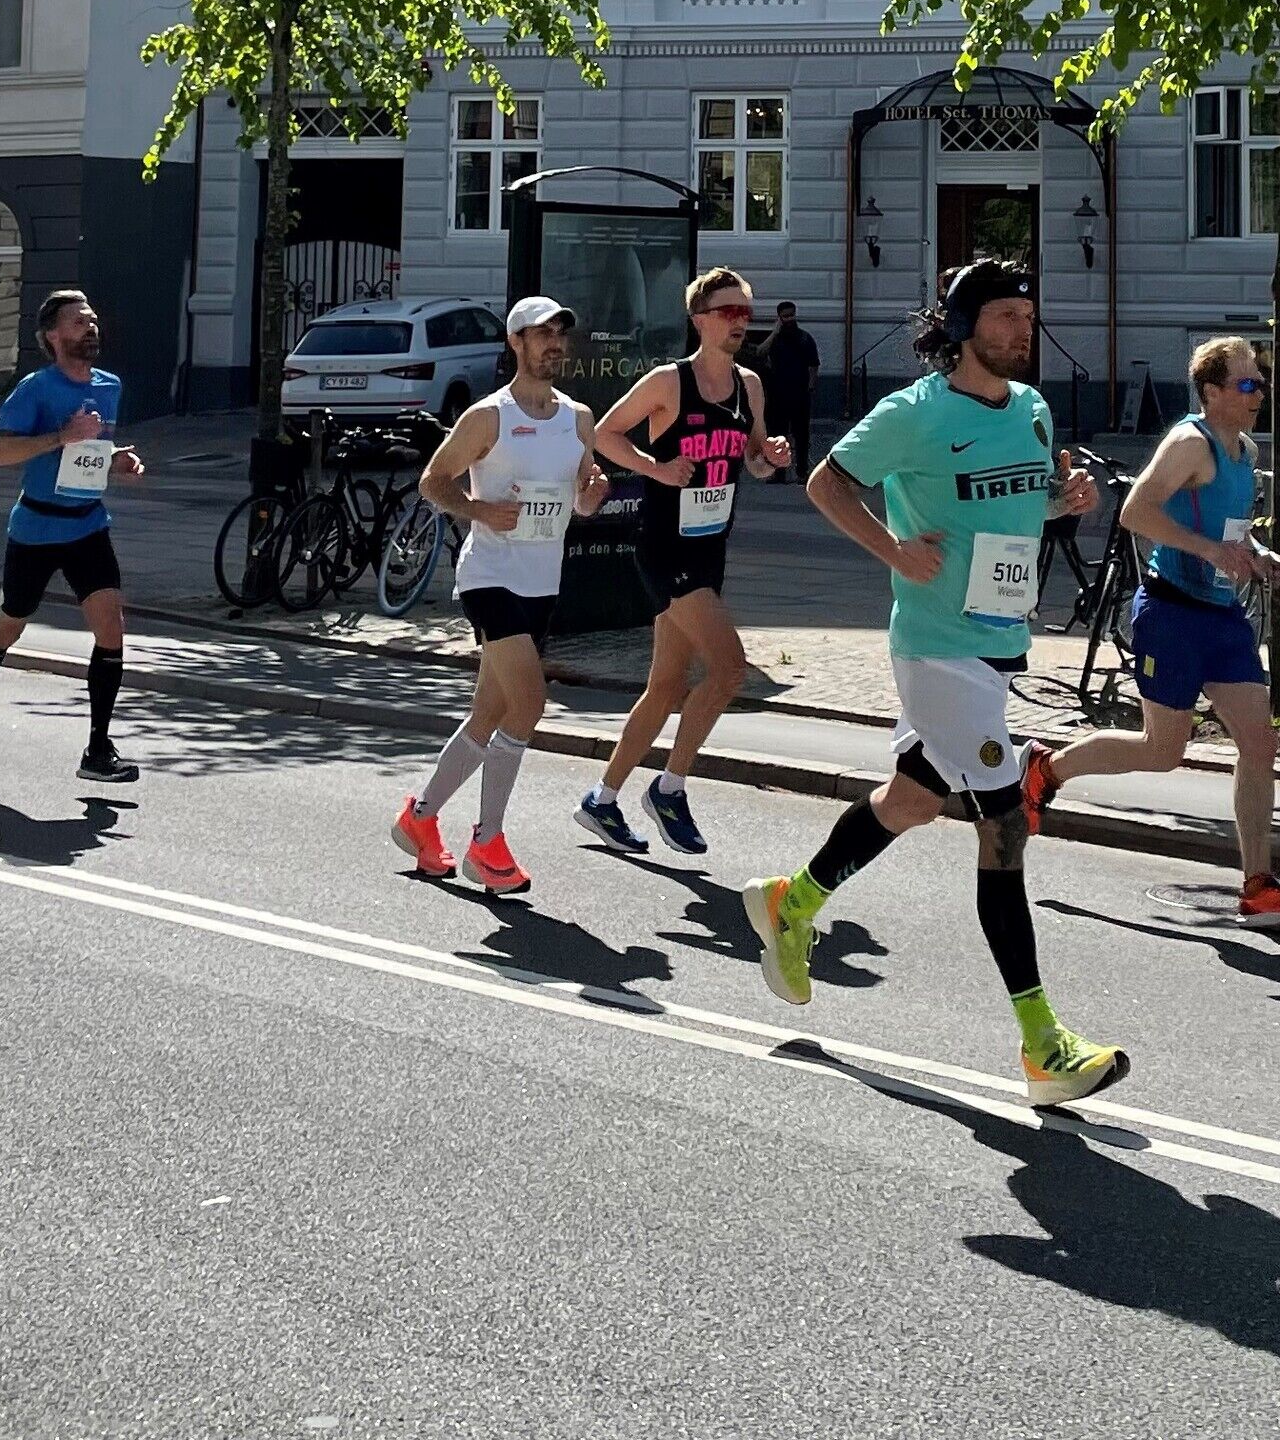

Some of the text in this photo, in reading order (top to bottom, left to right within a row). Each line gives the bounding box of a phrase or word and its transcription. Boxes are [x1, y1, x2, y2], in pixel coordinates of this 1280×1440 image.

[885, 105, 1052, 120] HOTEL Sct. THOMAS
[604, 343, 622, 353] THE
[706, 459, 729, 488] 10
[693, 487, 727, 504] 11026
[524, 501, 563, 516] 11377
[569, 543, 583, 558] på
[589, 543, 611, 555] den
[993, 562, 1030, 584] 5104
